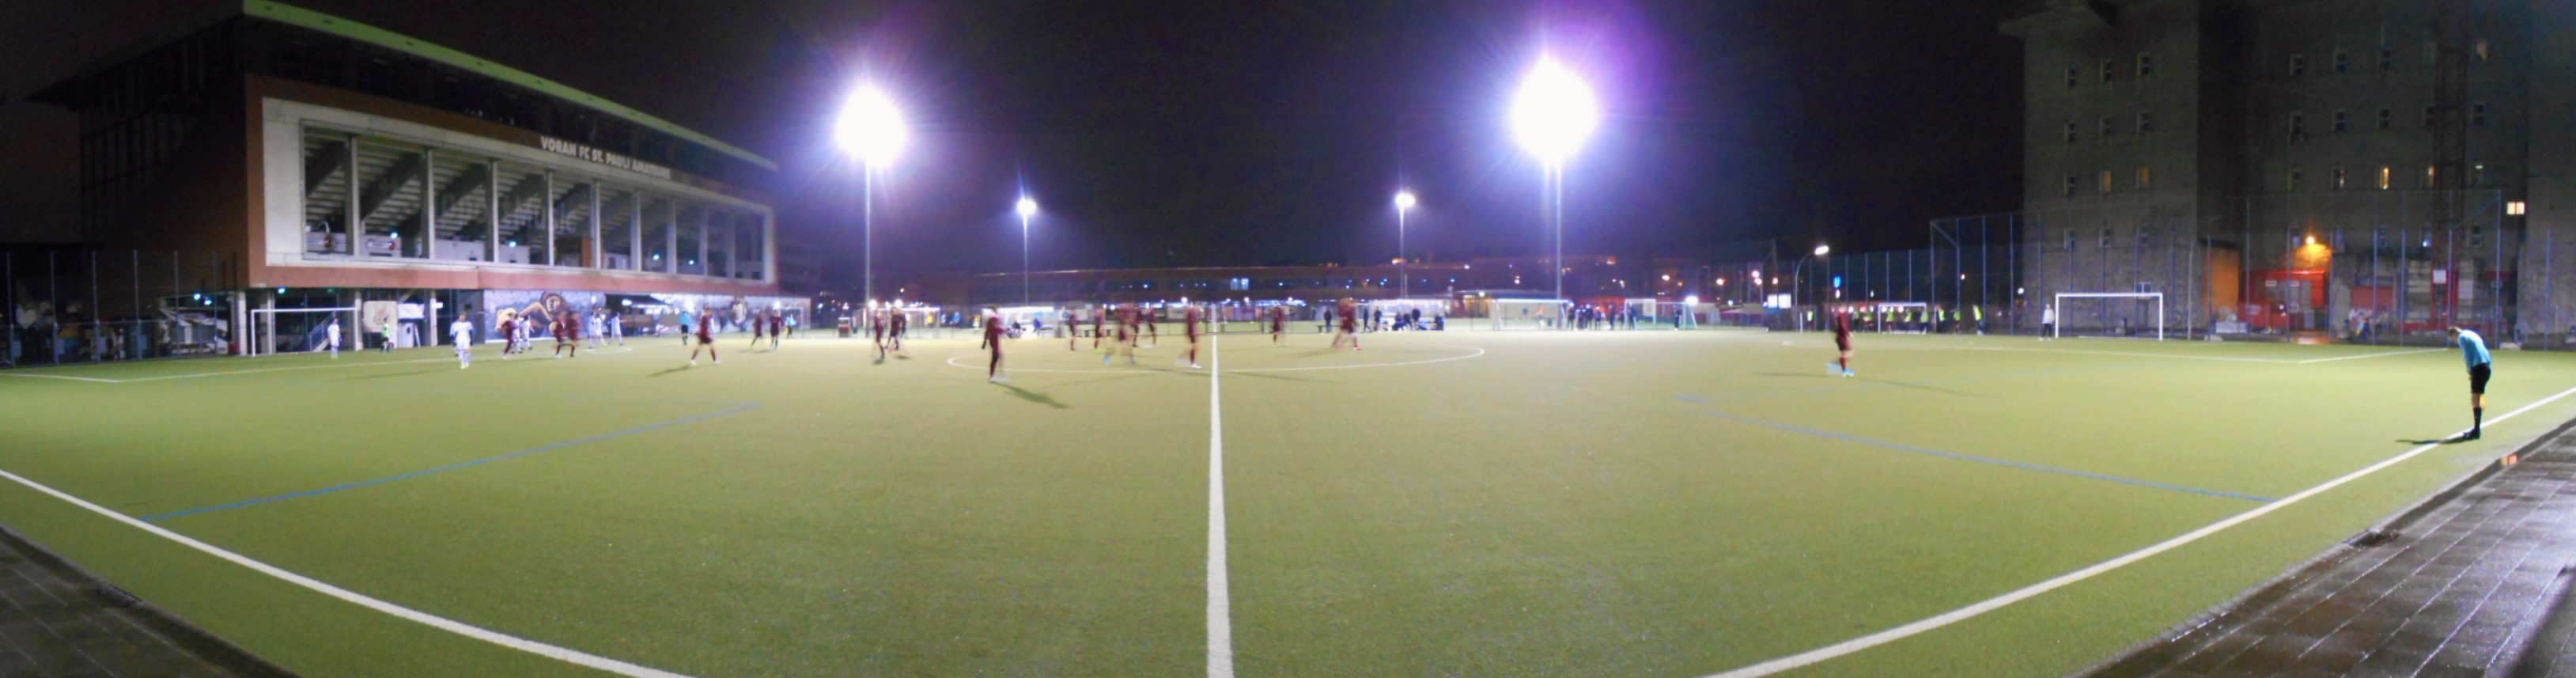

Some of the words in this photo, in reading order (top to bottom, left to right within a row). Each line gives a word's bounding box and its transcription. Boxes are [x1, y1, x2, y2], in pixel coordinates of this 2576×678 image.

[541, 136, 577, 156] VORAN
[579, 145, 590, 161] FC
[606, 151, 630, 169] PAULI
